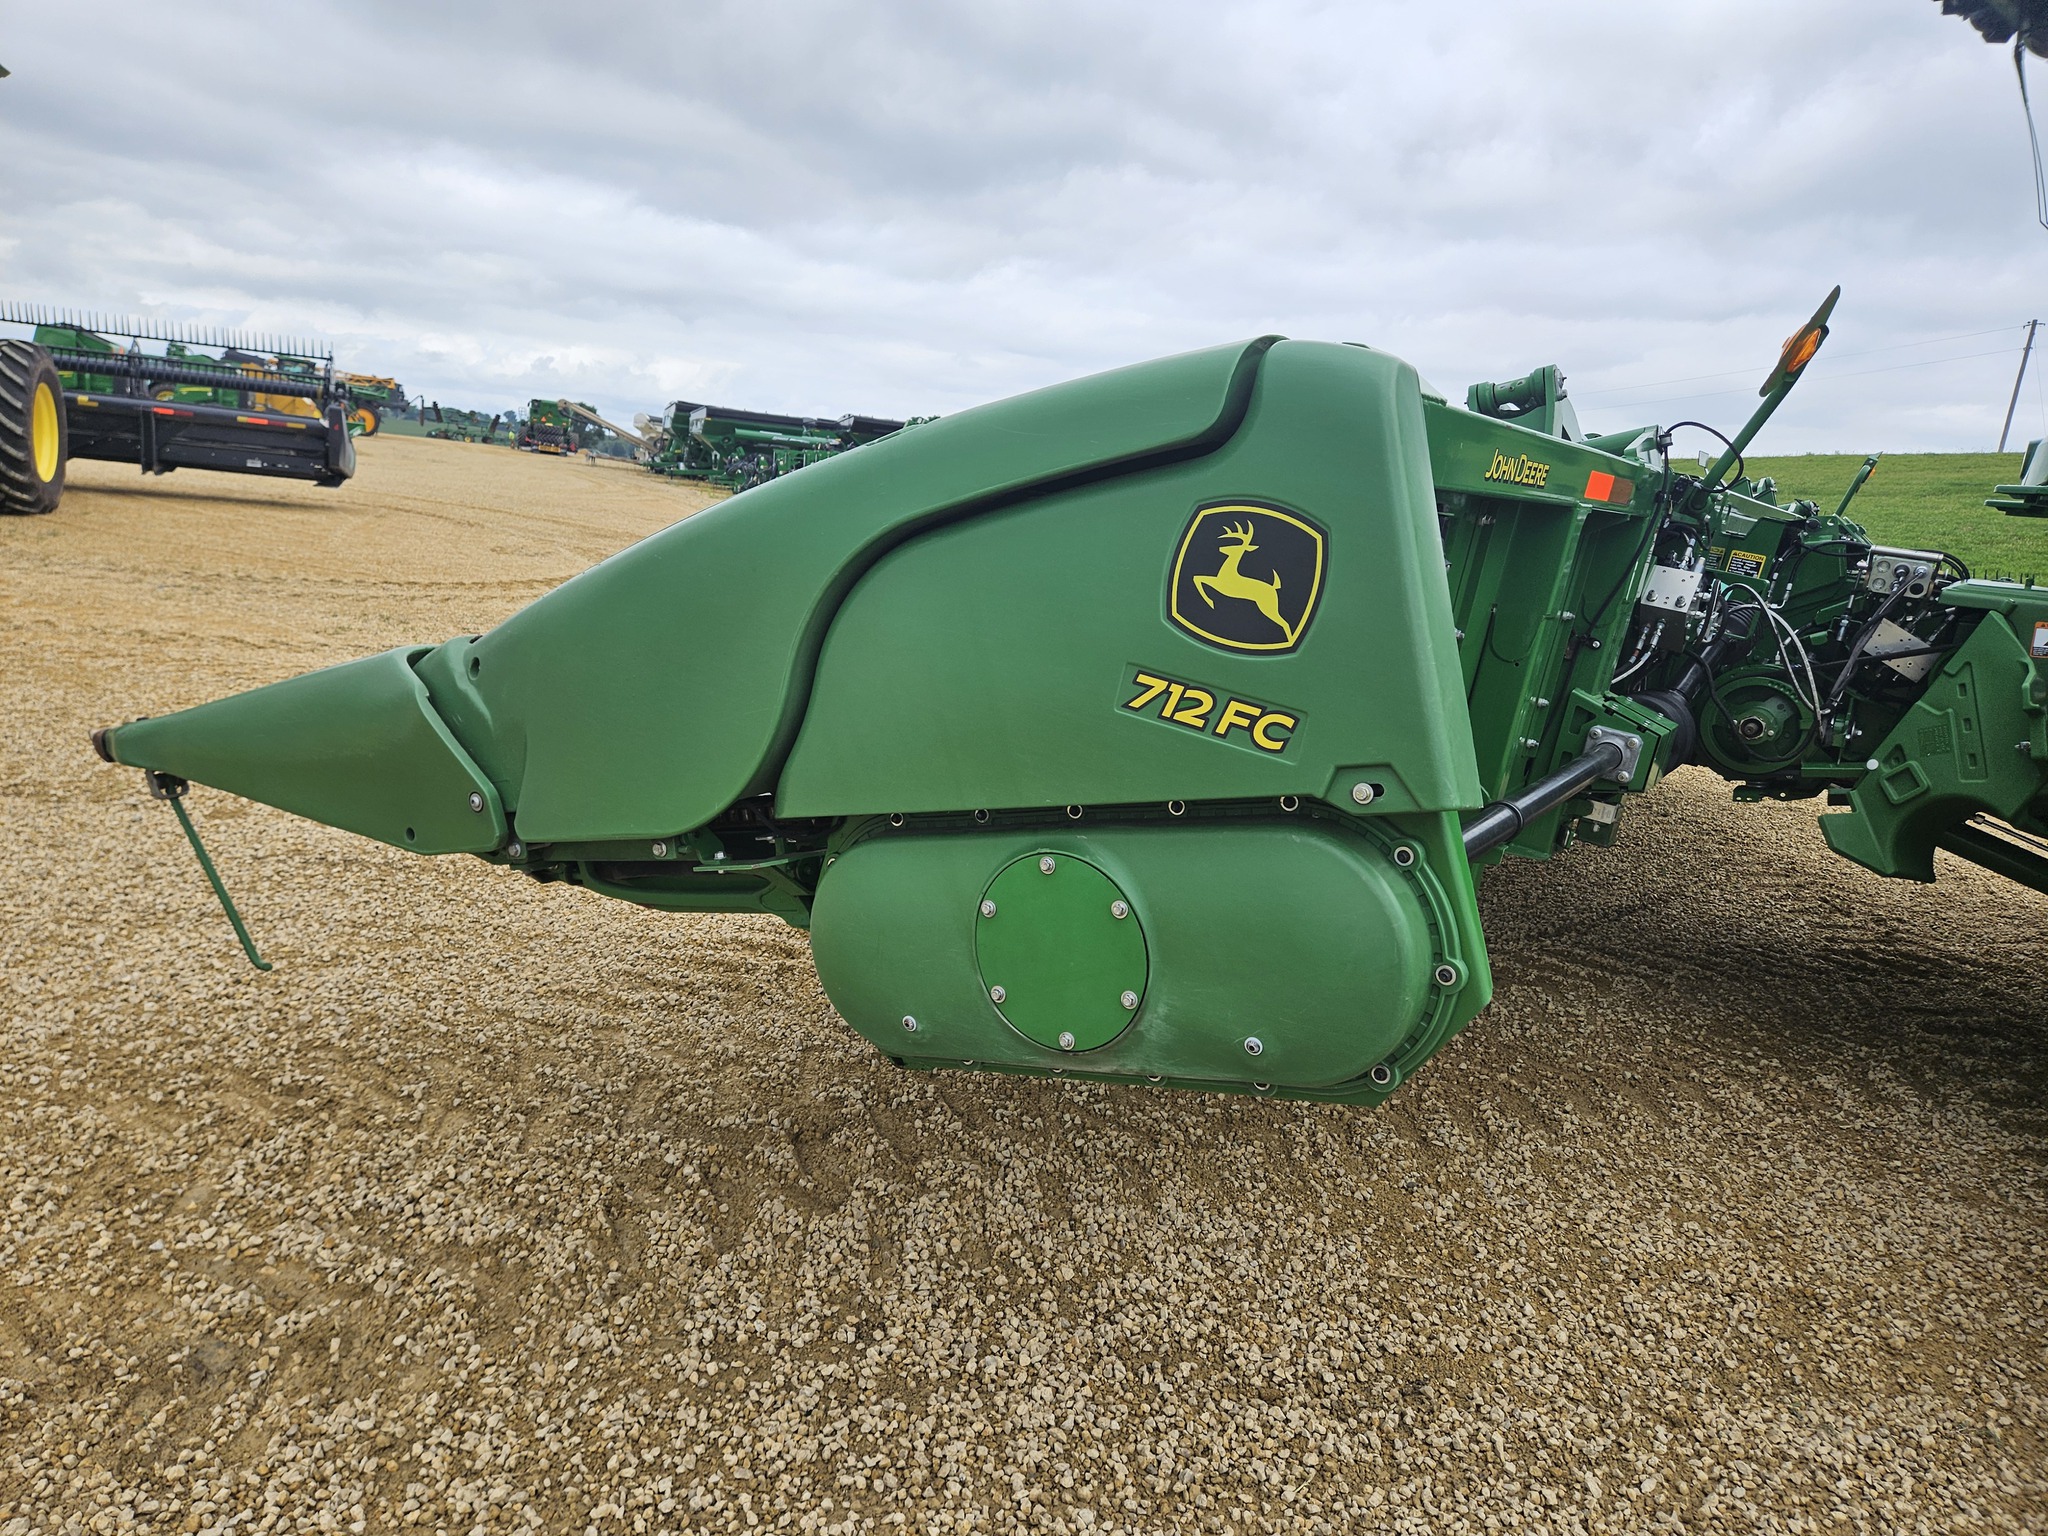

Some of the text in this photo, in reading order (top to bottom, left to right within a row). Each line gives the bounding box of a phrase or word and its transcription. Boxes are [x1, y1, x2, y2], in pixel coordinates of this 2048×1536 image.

[1485, 448, 1550, 487] JOHN DEERE
[1737, 552, 1764, 561] CAUTION
[1127, 671, 1298, 752] 712 FC
